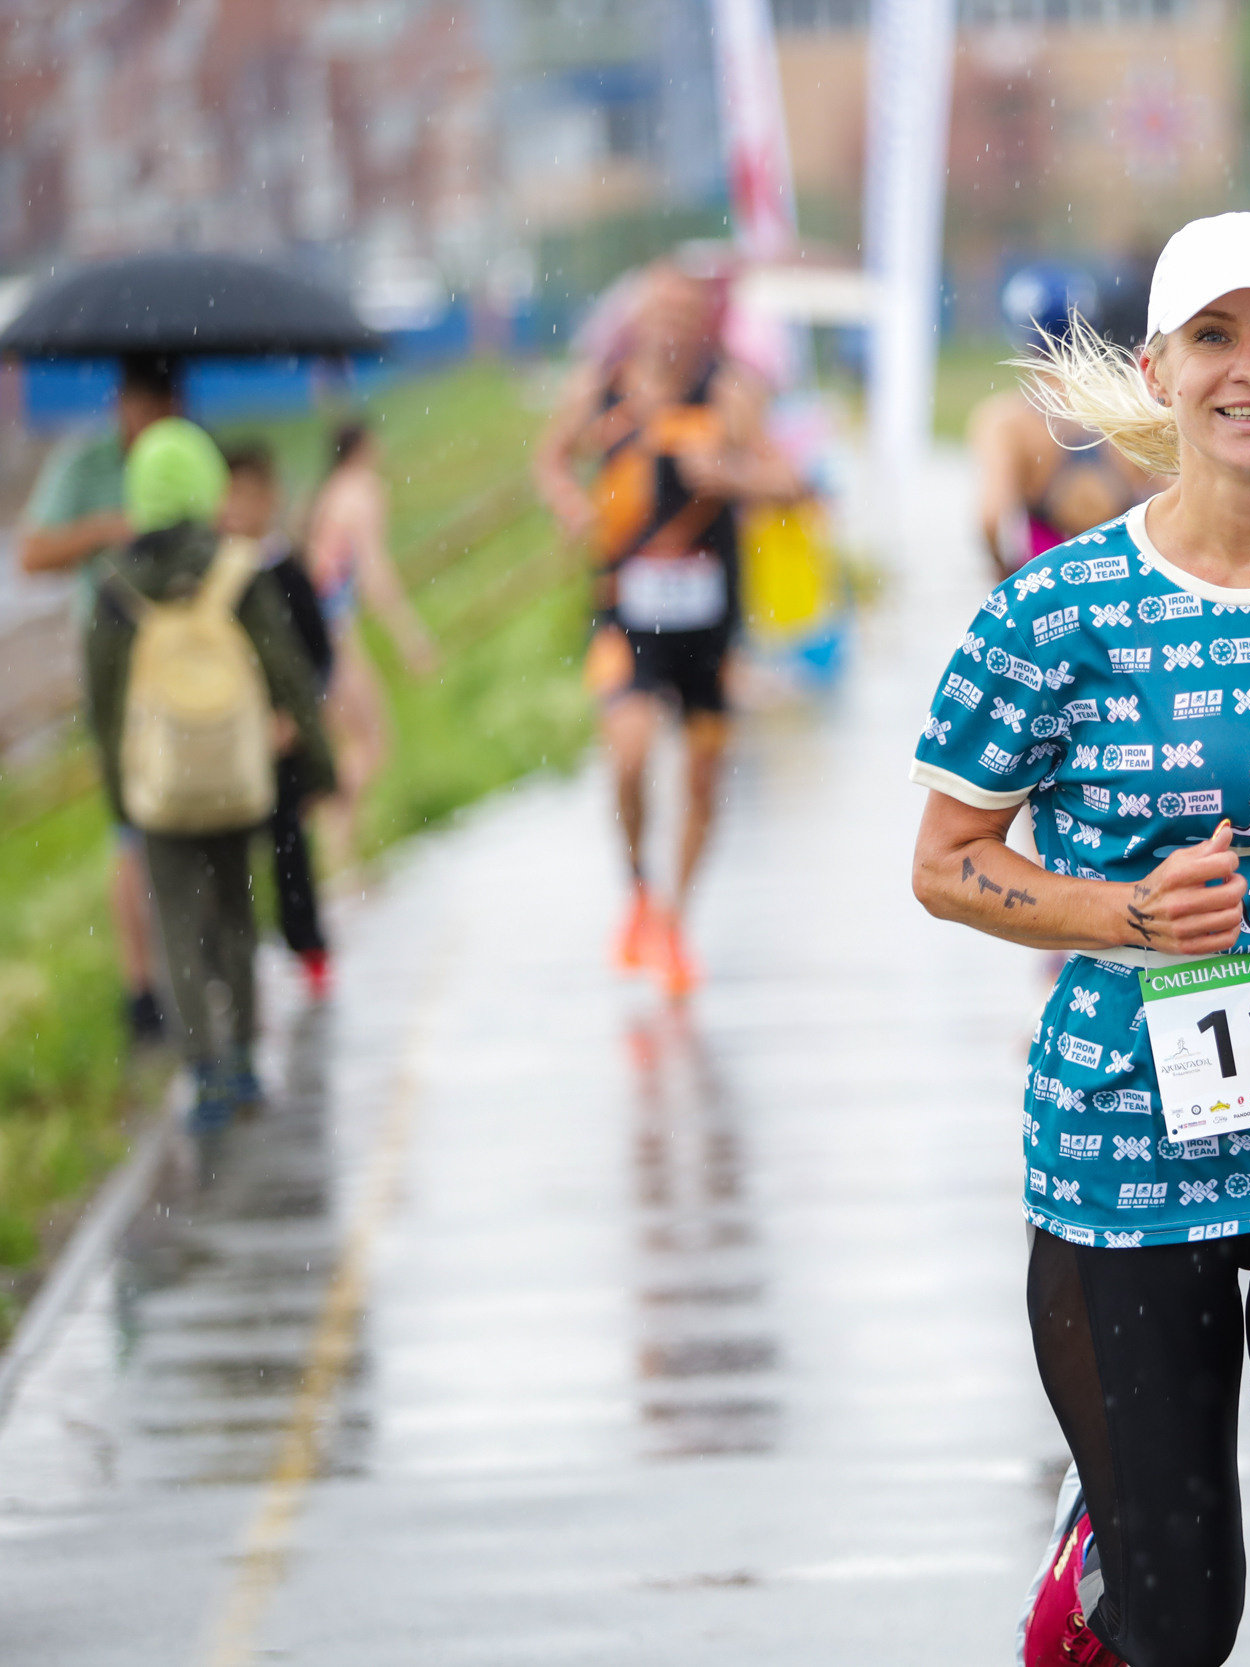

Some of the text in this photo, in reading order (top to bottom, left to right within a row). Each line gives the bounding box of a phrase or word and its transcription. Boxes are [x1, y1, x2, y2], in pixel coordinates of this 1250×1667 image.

[1093, 559, 1120, 569] IRON
[1095, 568, 1126, 578] TEAM
[1168, 595, 1194, 605] IRON
[1170, 606, 1199, 616] TEAM
[1034, 622, 1080, 643] TRIATHLON
[1013, 661, 1037, 677] IRON
[1012, 670, 1039, 688] TEAM
[1071, 702, 1092, 711] IRON
[1173, 705, 1221, 716] TRIATHLON
[1076, 711, 1098, 719] TEAM
[1124, 749, 1146, 757] IRON
[1188, 794, 1215, 803] IRON
[1189, 804, 1219, 813] TEAM
[1073, 1040, 1096, 1054] IRON
[1070, 1051, 1096, 1066] TEAM
[1123, 1092, 1144, 1102] IRON
[1124, 1102, 1149, 1112] TEAM
[1187, 1138, 1212, 1147] IRON
[1060, 1146, 1099, 1157] TRIATHLON
[1188, 1149, 1217, 1157] TEAM
[1069, 1229, 1088, 1238] IRON
